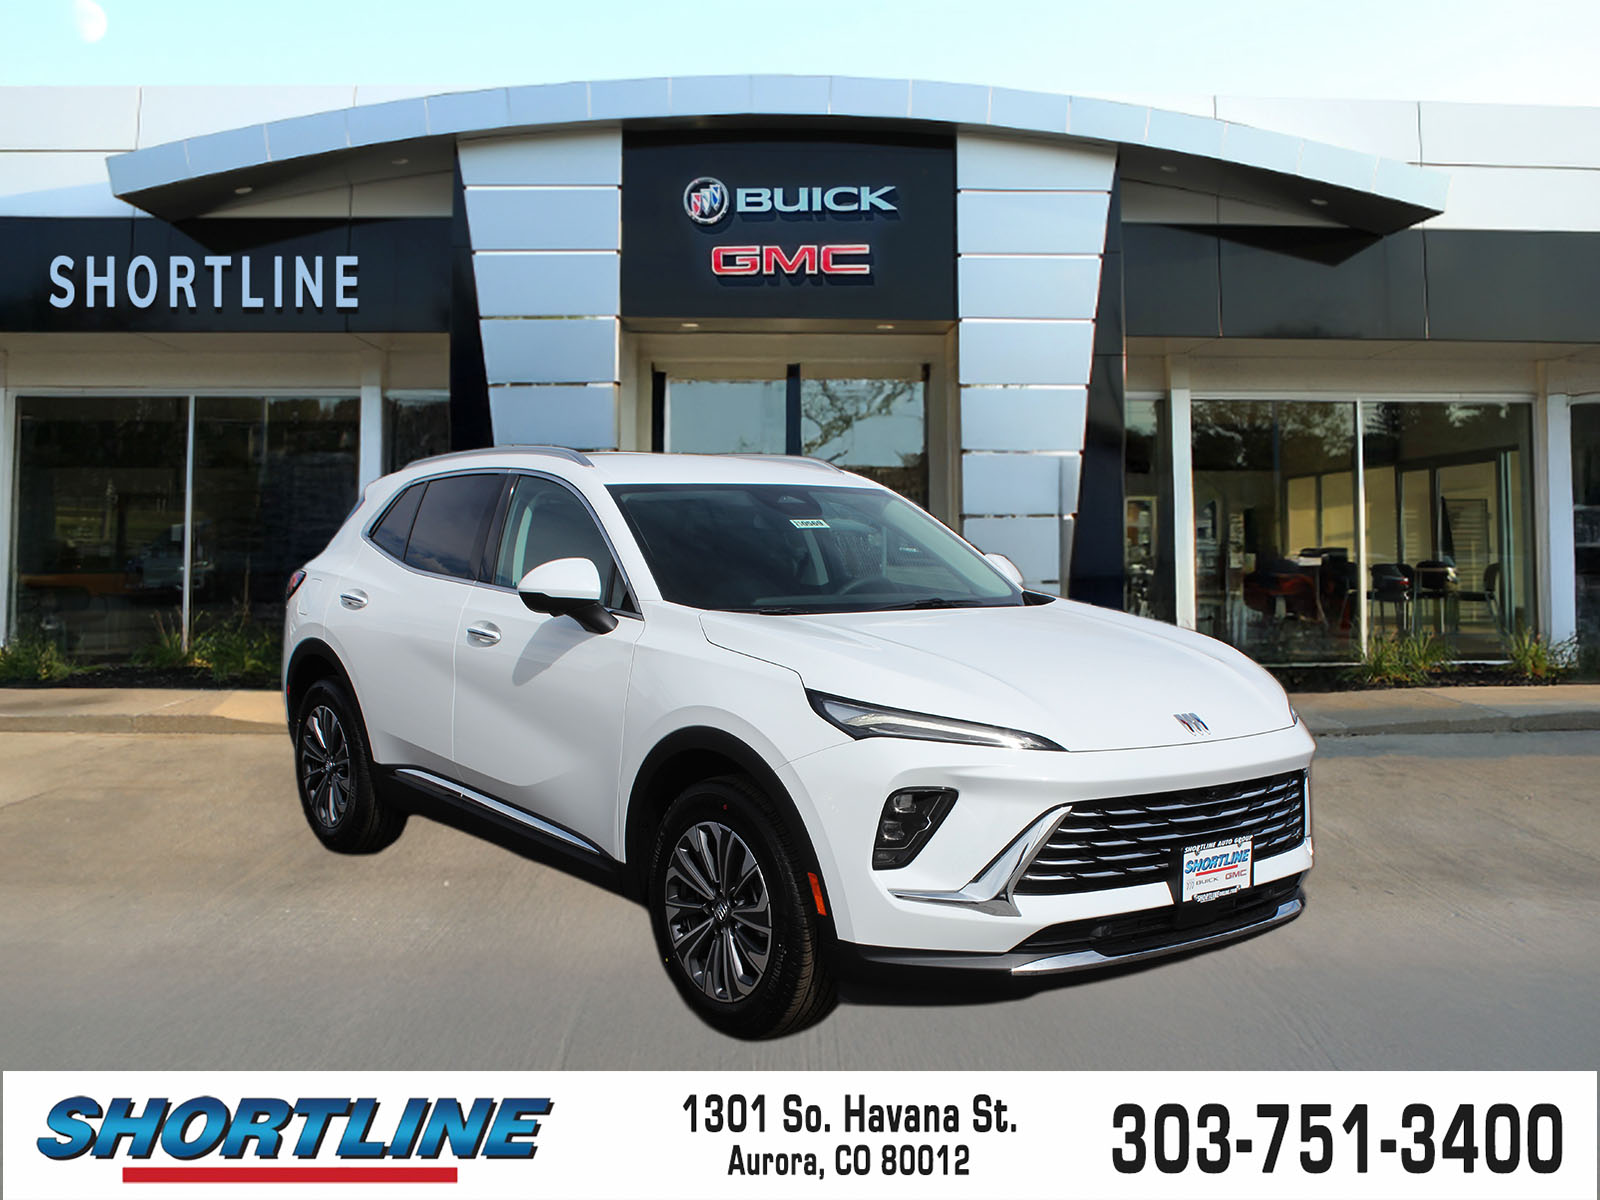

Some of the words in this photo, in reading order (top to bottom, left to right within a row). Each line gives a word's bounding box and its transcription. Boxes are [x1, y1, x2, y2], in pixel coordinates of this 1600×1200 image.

[736, 185, 898, 213] BUICK
[711, 244, 871, 276] GMC
[49, 255, 359, 309] SHORTLINE
[1217, 839, 1232, 847] AUTO
[1185, 849, 1250, 874] SHORTLINE
[1196, 877, 1218, 885] BUICK
[1225, 869, 1247, 880] GMC
